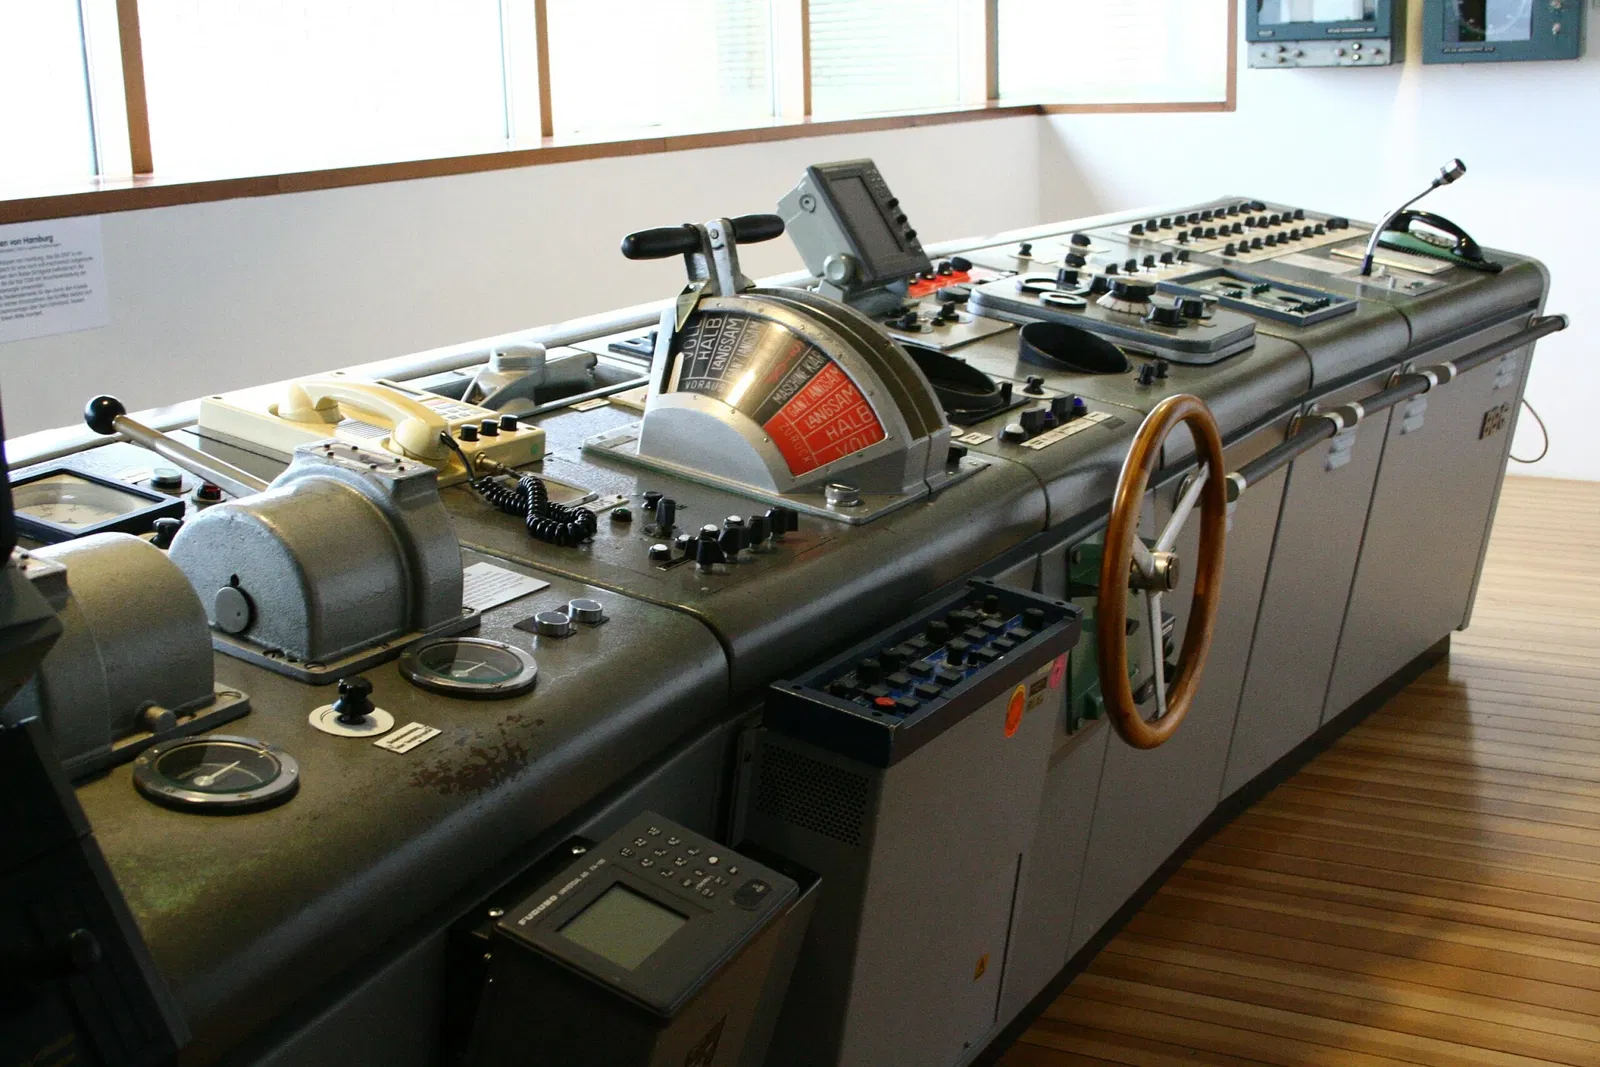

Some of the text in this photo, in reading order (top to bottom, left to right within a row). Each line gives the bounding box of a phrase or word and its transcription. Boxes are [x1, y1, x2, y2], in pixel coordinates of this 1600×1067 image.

[10, 239, 22, 247] von
[23, 235, 53, 244] Hamburg
[684, 319, 703, 360] VOLL
[697, 317, 722, 360] HALB
[711, 318, 744, 371] LANGSAM
[726, 320, 760, 378] GANZ LANGSAM
[685, 379, 727, 392] VORAUS
[771, 366, 812, 405] MASCHINE
[801, 349, 827, 374] KLAR
[787, 365, 841, 418] GANZ LANGSAM
[804, 384, 859, 430] LANGSAM
[825, 405, 875, 442] HALB
[516, 894, 559, 926] FURUNO
